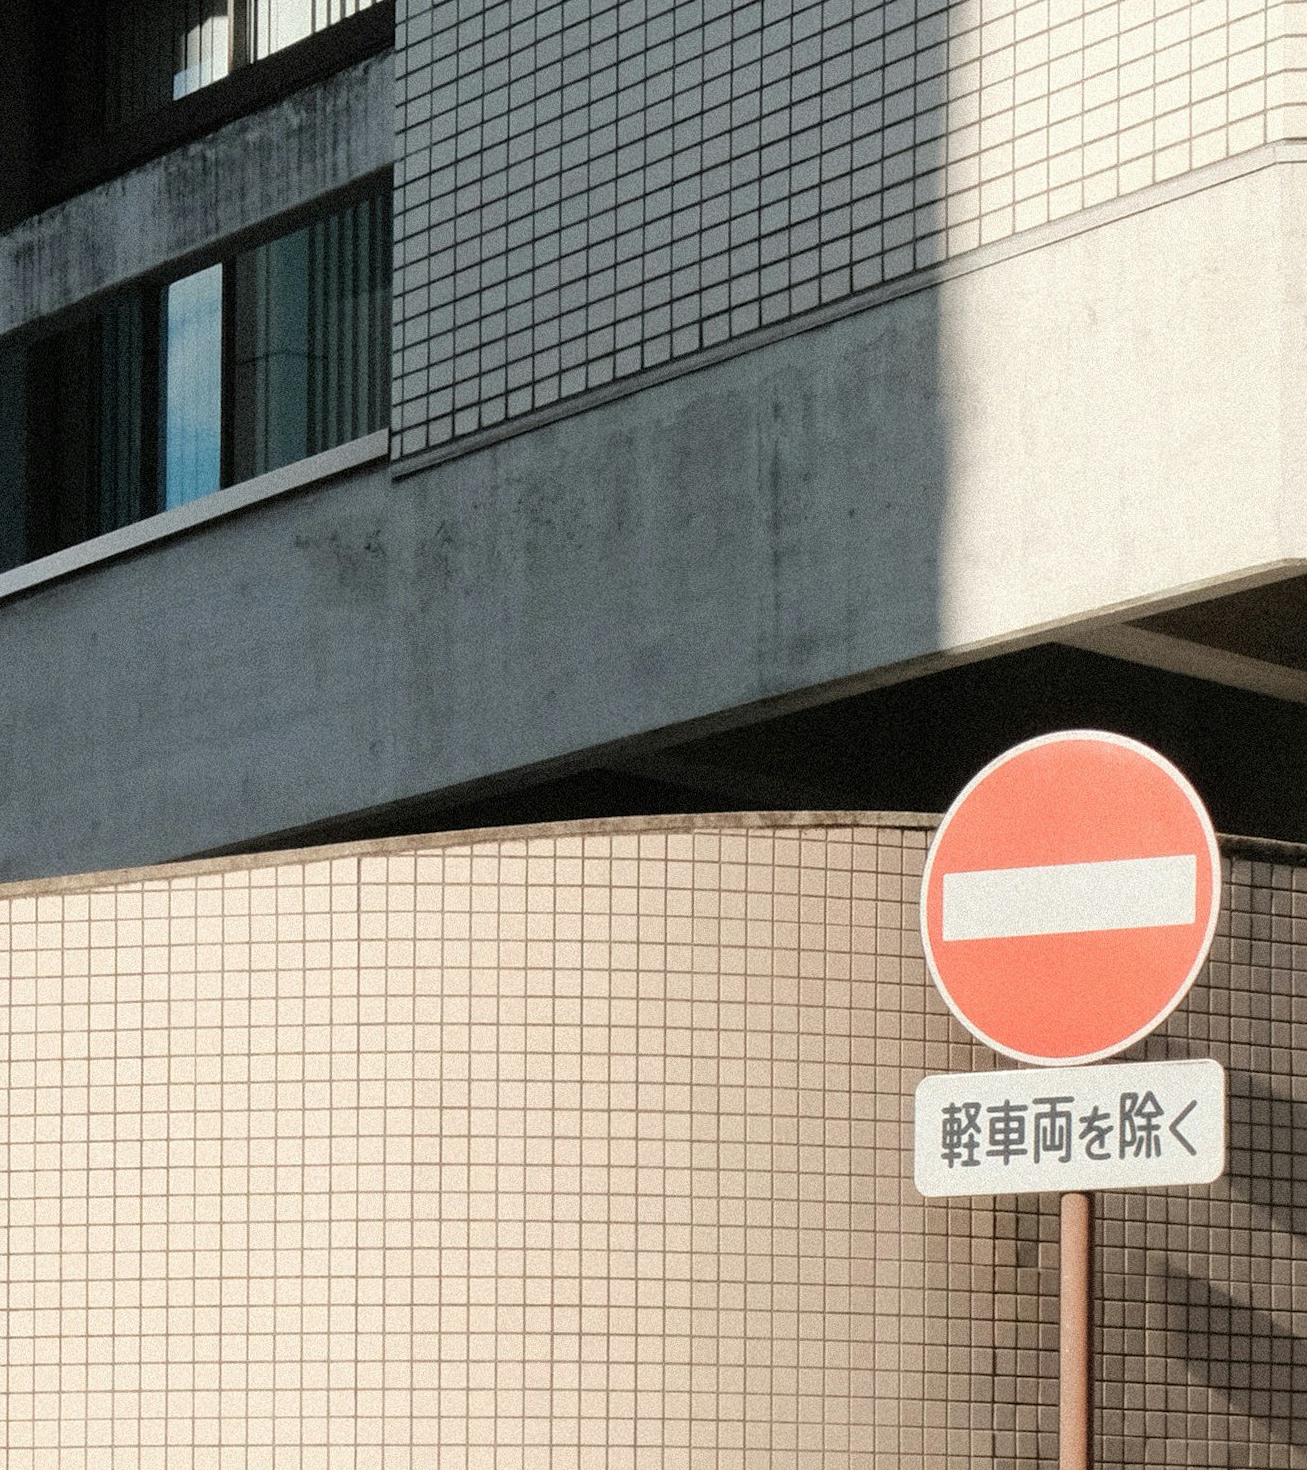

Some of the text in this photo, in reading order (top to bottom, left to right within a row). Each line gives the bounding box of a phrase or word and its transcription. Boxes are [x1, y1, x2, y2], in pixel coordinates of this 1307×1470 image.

[941, 1090, 1197, 1168] 軽車両を除く
